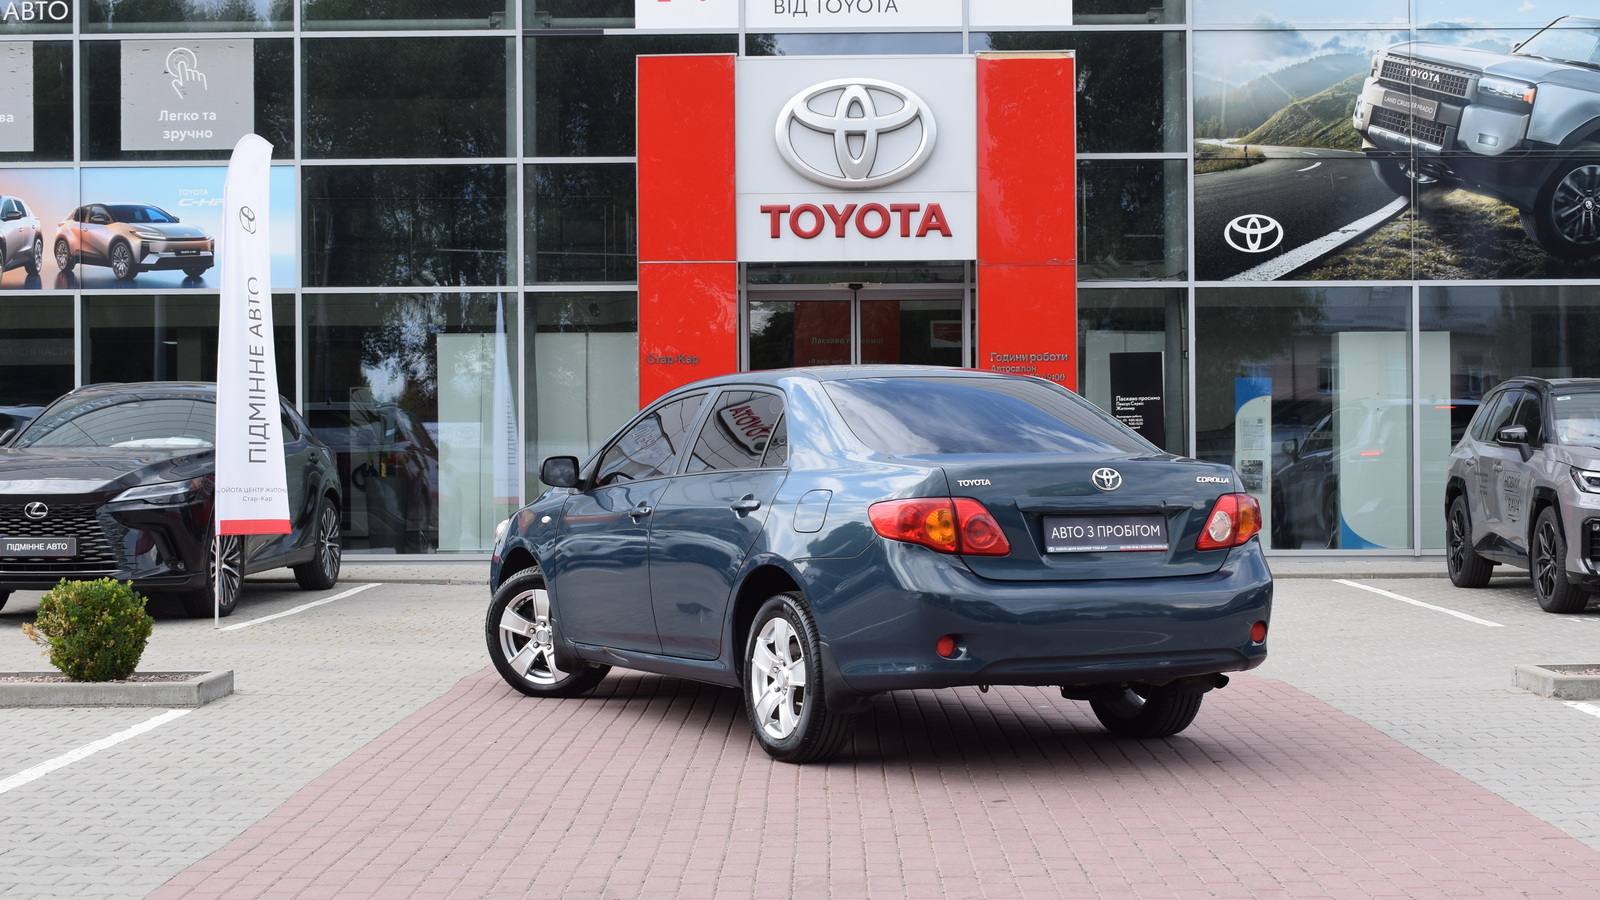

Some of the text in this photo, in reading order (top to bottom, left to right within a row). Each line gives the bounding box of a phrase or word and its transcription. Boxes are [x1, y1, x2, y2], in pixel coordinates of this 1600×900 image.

[3, 1, 68, 20] АВТО
[774, 0, 808, 17] ВІД
[1405, 67, 1440, 83] TOYOTA
[1384, 96, 1397, 104] LAND
[1417, 102, 1434, 114] PRADO
[158, 110, 217, 121] Легко та
[163, 130, 213, 141] зручно
[760, 203, 953, 239] TOYOTA
[646, 354, 700, 366] Стар-Кар
[990, 352, 1068, 363] Години роботи
[247, 277, 270, 463] ПІДМІННЕ АВТО
[991, 365, 1037, 373] Автосалон
[957, 479, 991, 487] TOYOTA
[1195, 476, 1229, 484] COROLLA
[217, 486, 242, 494] ОЙОТА
[243, 486, 264, 494] ЦЕНТР
[242, 495, 273, 503] Стар-Кар
[1051, 524, 1160, 539] АВТО З ПРОБІГОМ
[6, 543, 44, 551] ПІДМІННЕ
